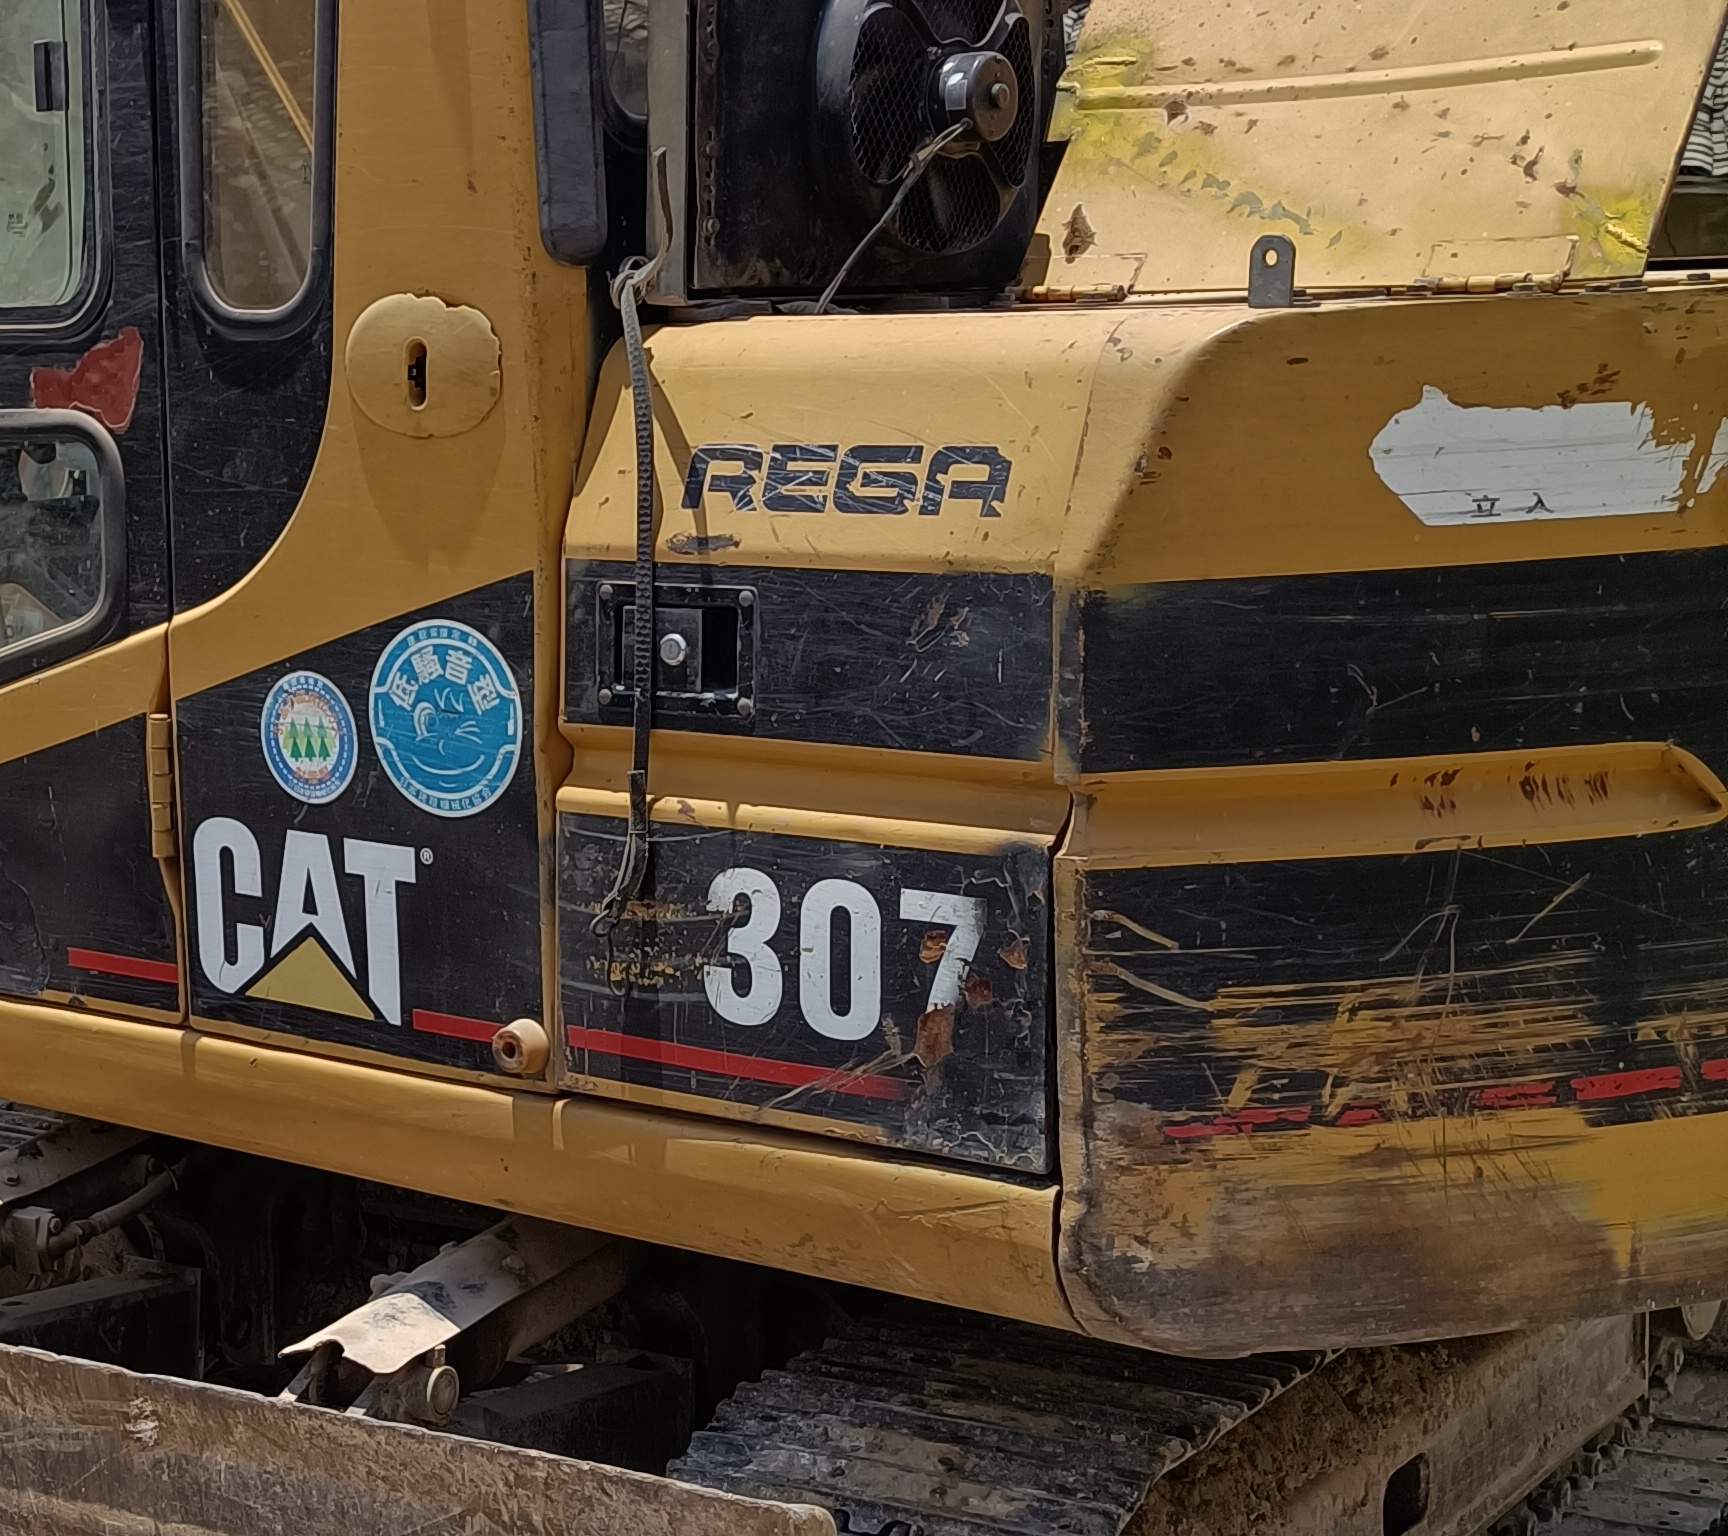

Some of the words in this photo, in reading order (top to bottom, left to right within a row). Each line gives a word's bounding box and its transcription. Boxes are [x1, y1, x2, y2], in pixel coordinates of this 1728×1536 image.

[680, 443, 1013, 518] REGA
[192, 816, 418, 1027] CAT
[703, 866, 989, 1042] 307
